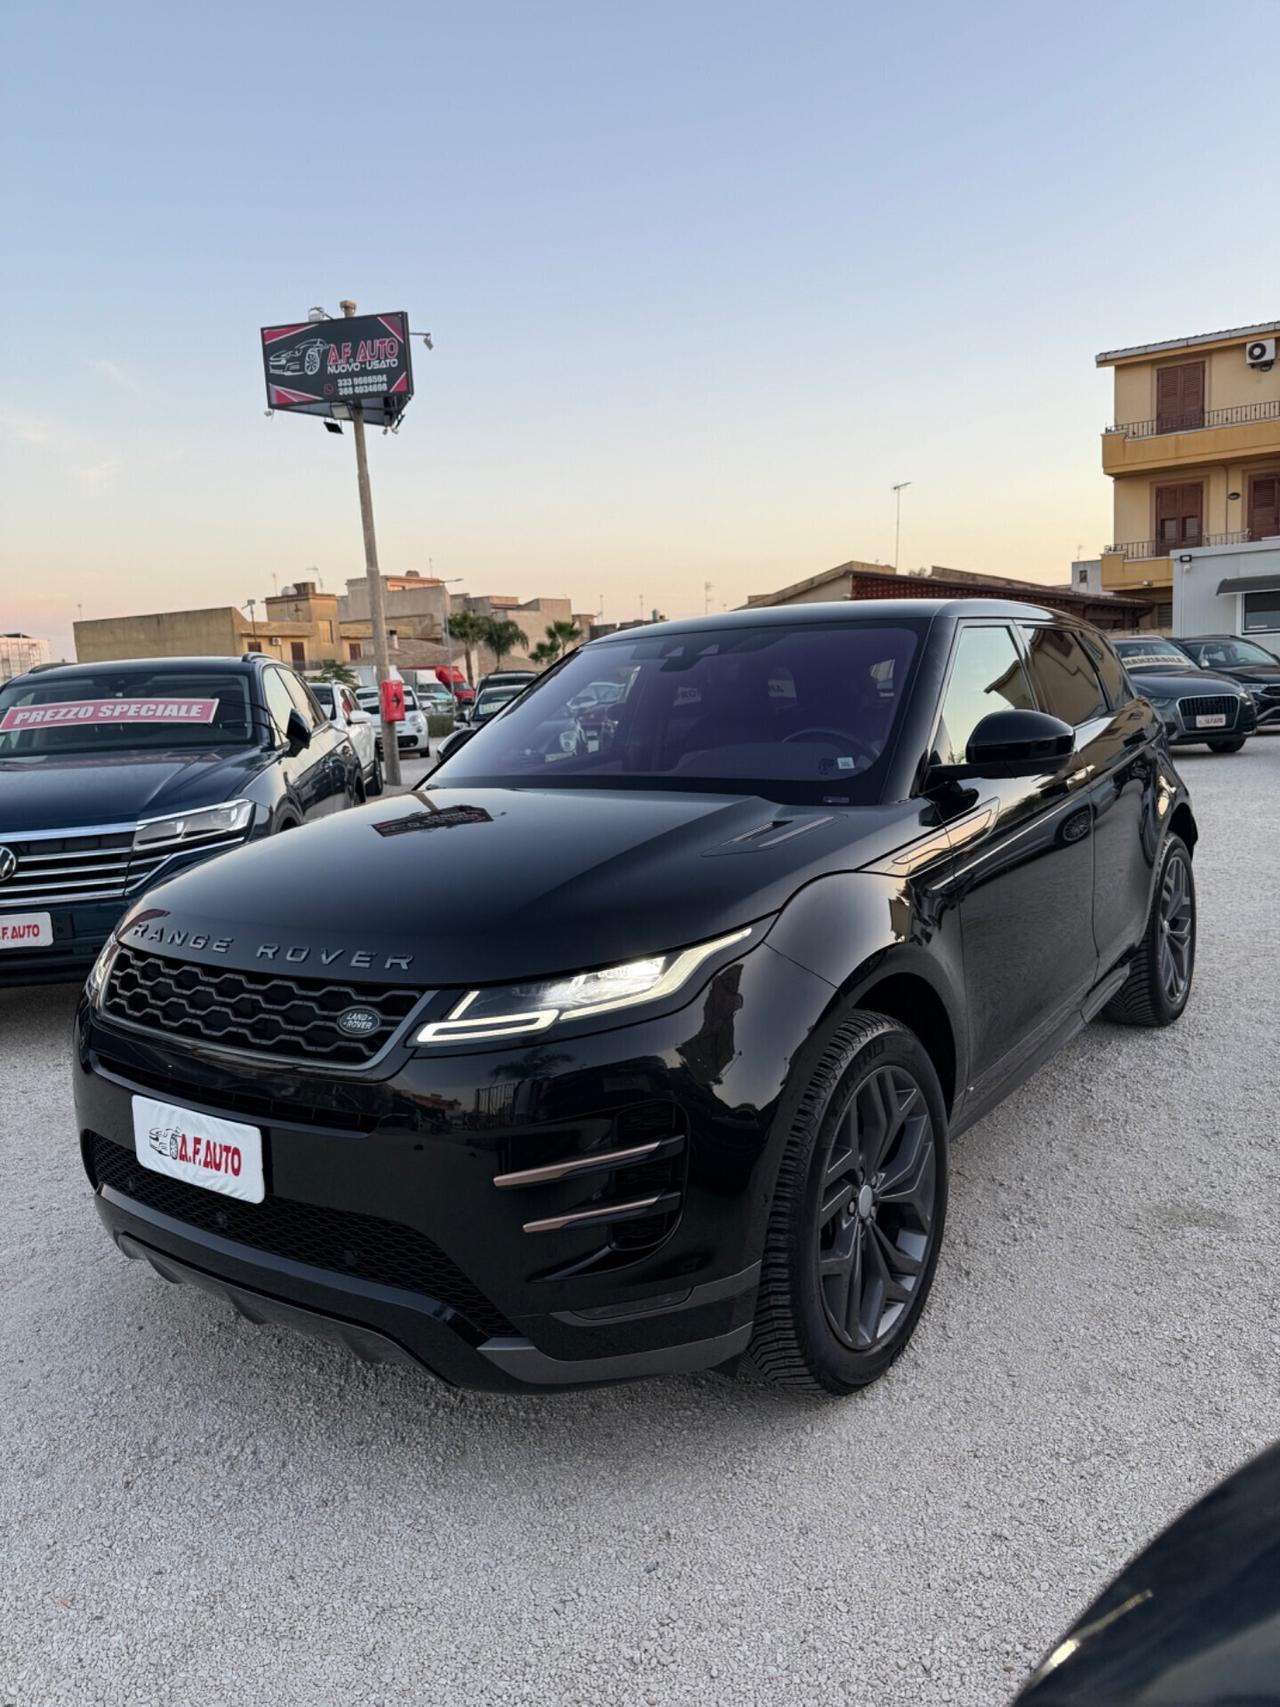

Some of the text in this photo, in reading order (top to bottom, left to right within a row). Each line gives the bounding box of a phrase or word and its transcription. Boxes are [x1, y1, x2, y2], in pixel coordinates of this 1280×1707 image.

[356, 337, 398, 362] AUTO
[327, 358, 398, 374] NUOVO USATO
[13, 703, 203, 725] PREZZO SPECIALE
[0, 924, 40, 940] F.AUTO
[133, 923, 414, 970] RANGE ROVER
